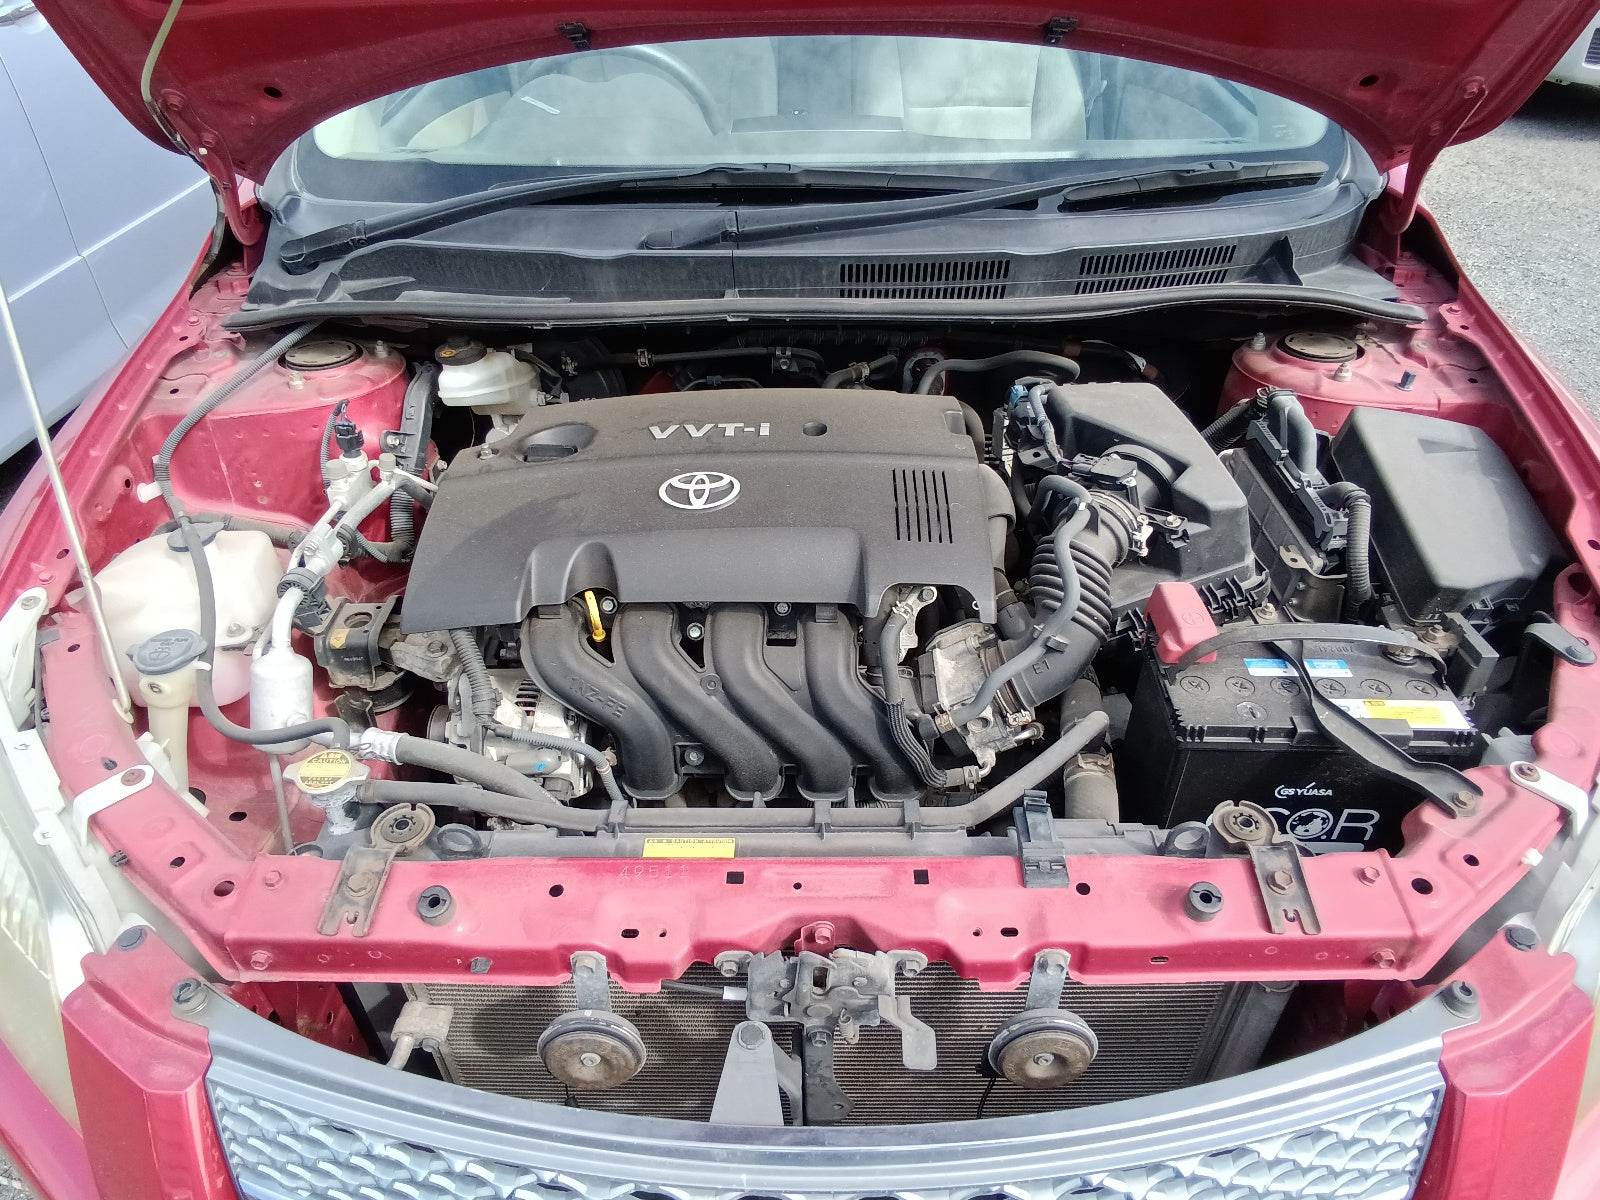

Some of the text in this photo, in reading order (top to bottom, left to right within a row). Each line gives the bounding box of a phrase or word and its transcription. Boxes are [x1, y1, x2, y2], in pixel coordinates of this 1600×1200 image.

[648, 422, 771, 440] VVT-i
[1297, 782, 1333, 796] YUASA
[618, 865, 689, 879] 49511
